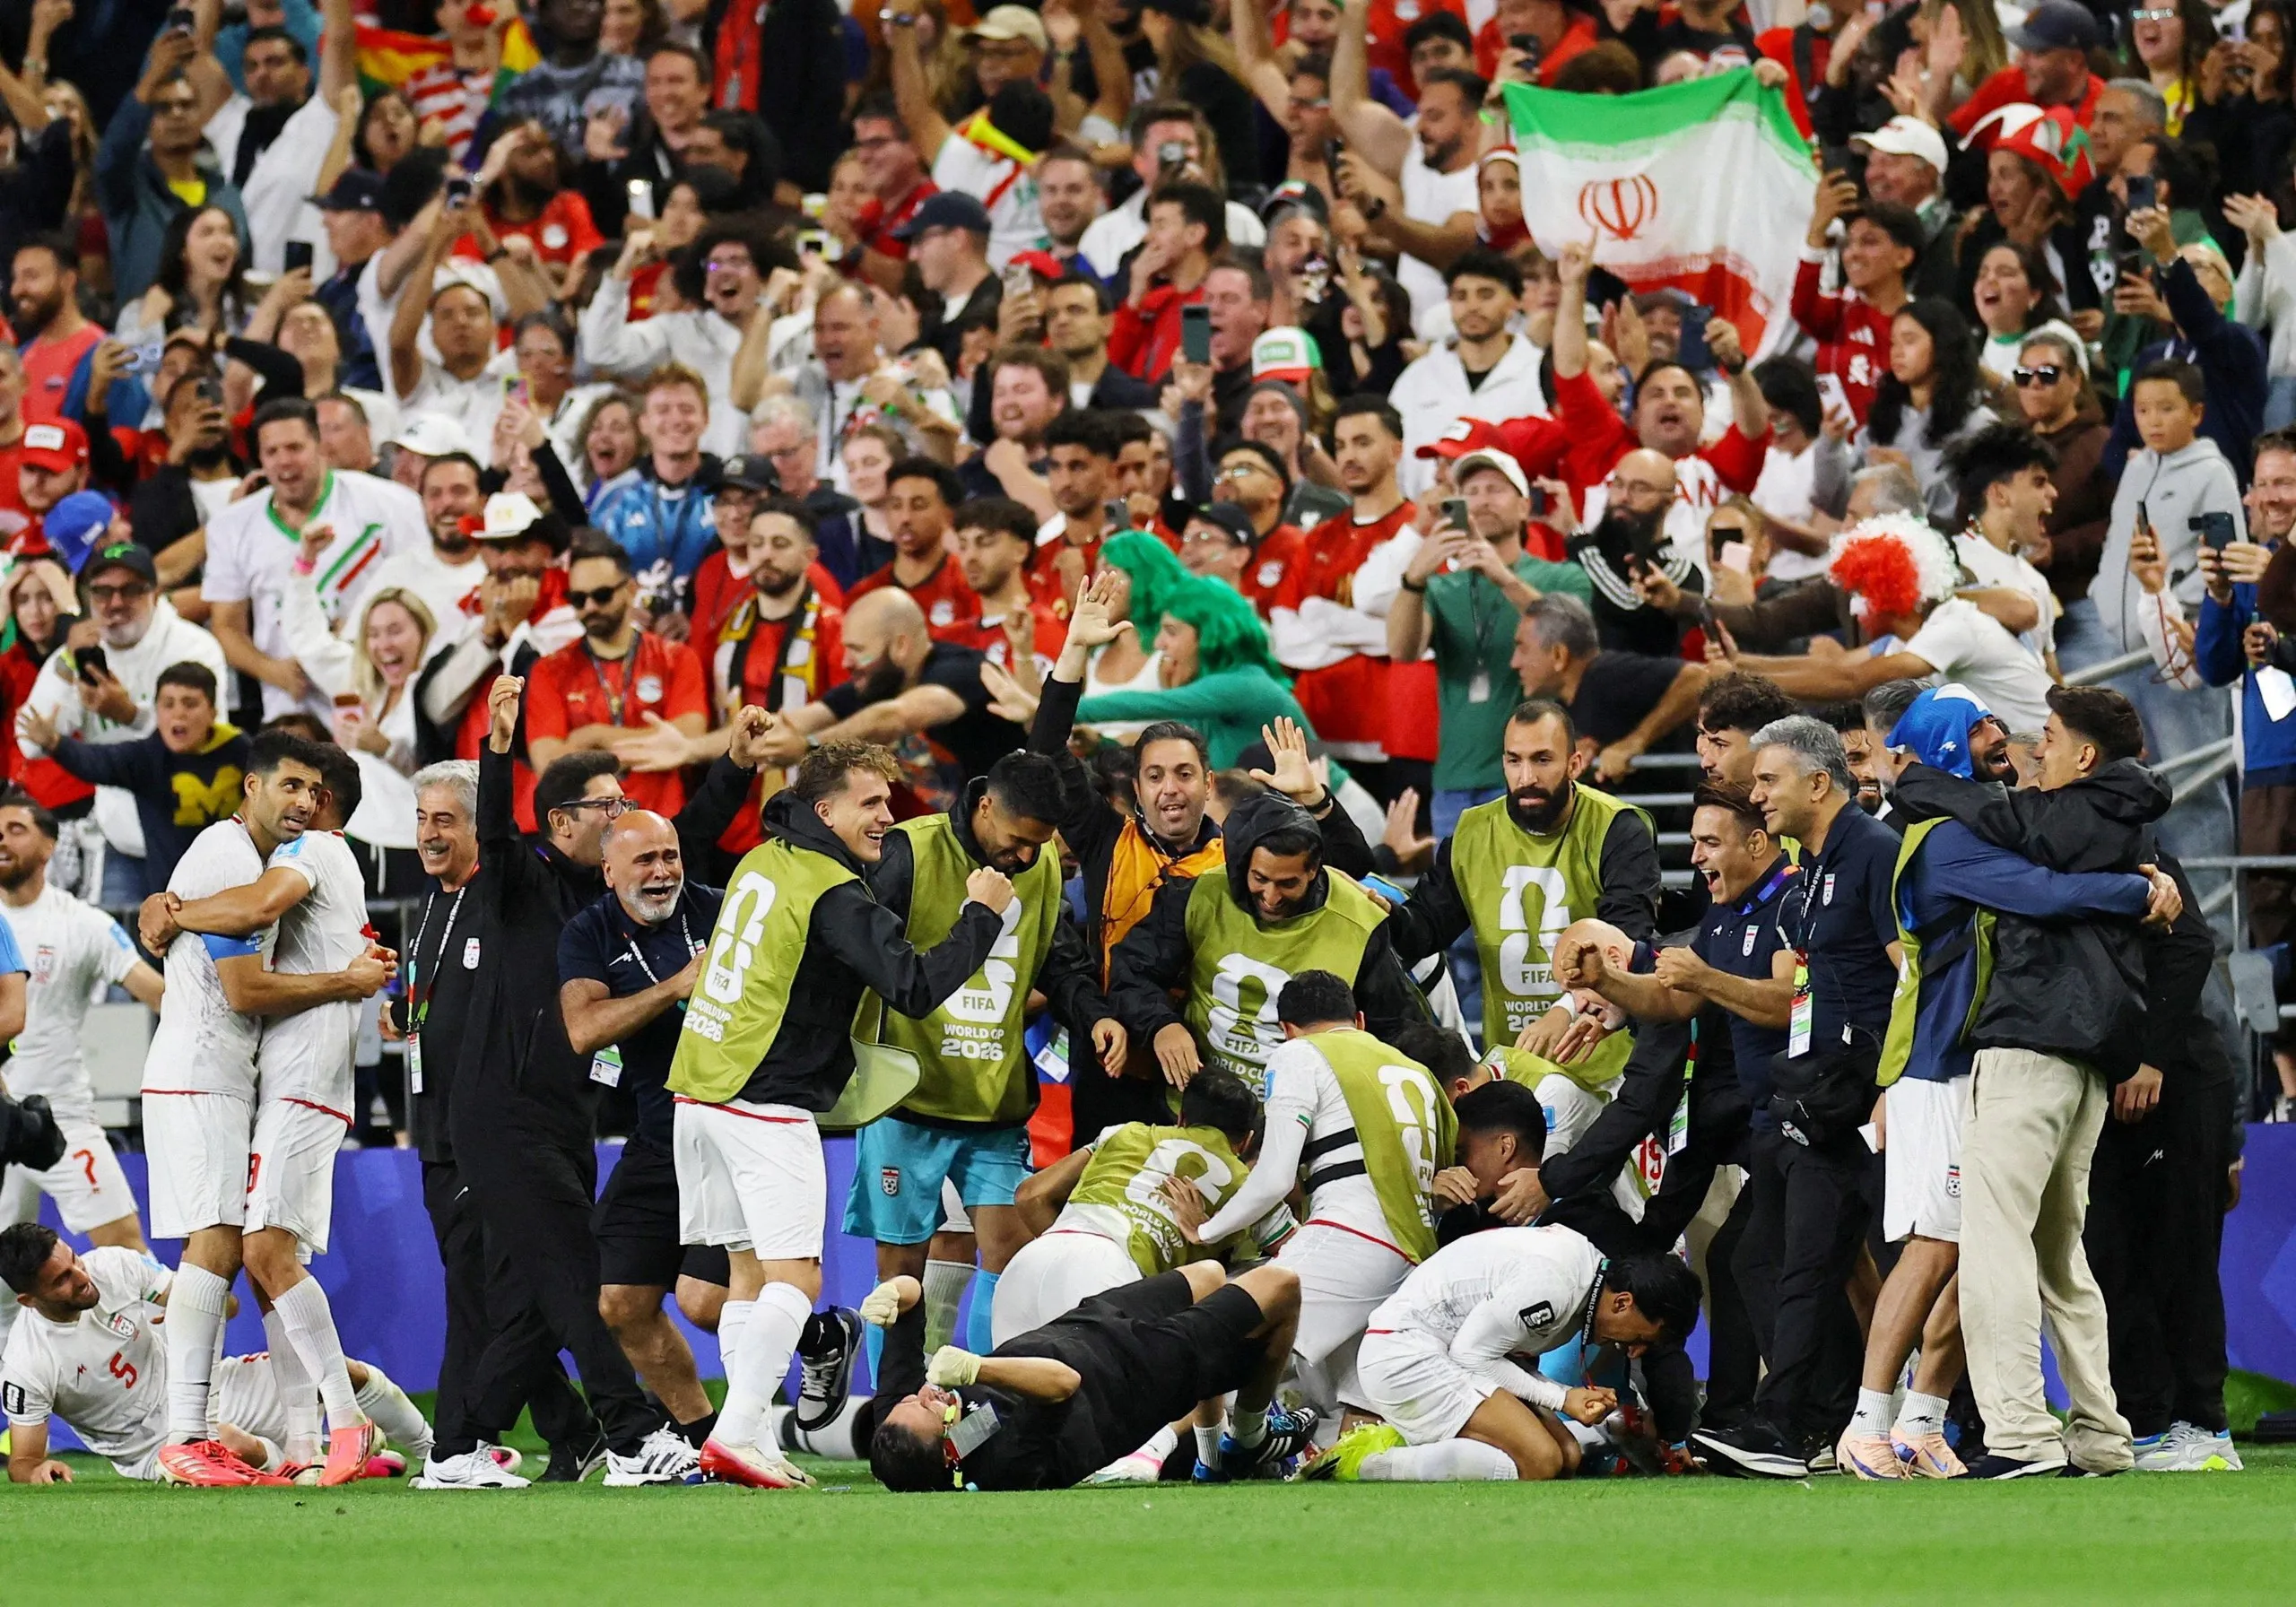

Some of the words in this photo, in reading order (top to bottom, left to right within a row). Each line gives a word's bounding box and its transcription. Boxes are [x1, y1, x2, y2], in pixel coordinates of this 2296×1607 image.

[171, 765, 242, 827] M
[1521, 969, 1557, 984] FIFA
[961, 995, 996, 1011] FIFA
[1504, 1000, 1552, 1012] WORLD
[683, 1010, 725, 1043] 2026
[943, 1023, 989, 1039] WORLD
[940, 1038, 1004, 1062] 2026
[1224, 1037, 1260, 1054] FIFA
[1118, 1202, 1163, 1228] WORLD
[1594, 1273, 1605, 1289] FIFA
[1588, 1287, 1600, 1310] WORLD
[109, 1351, 137, 1389] 5
